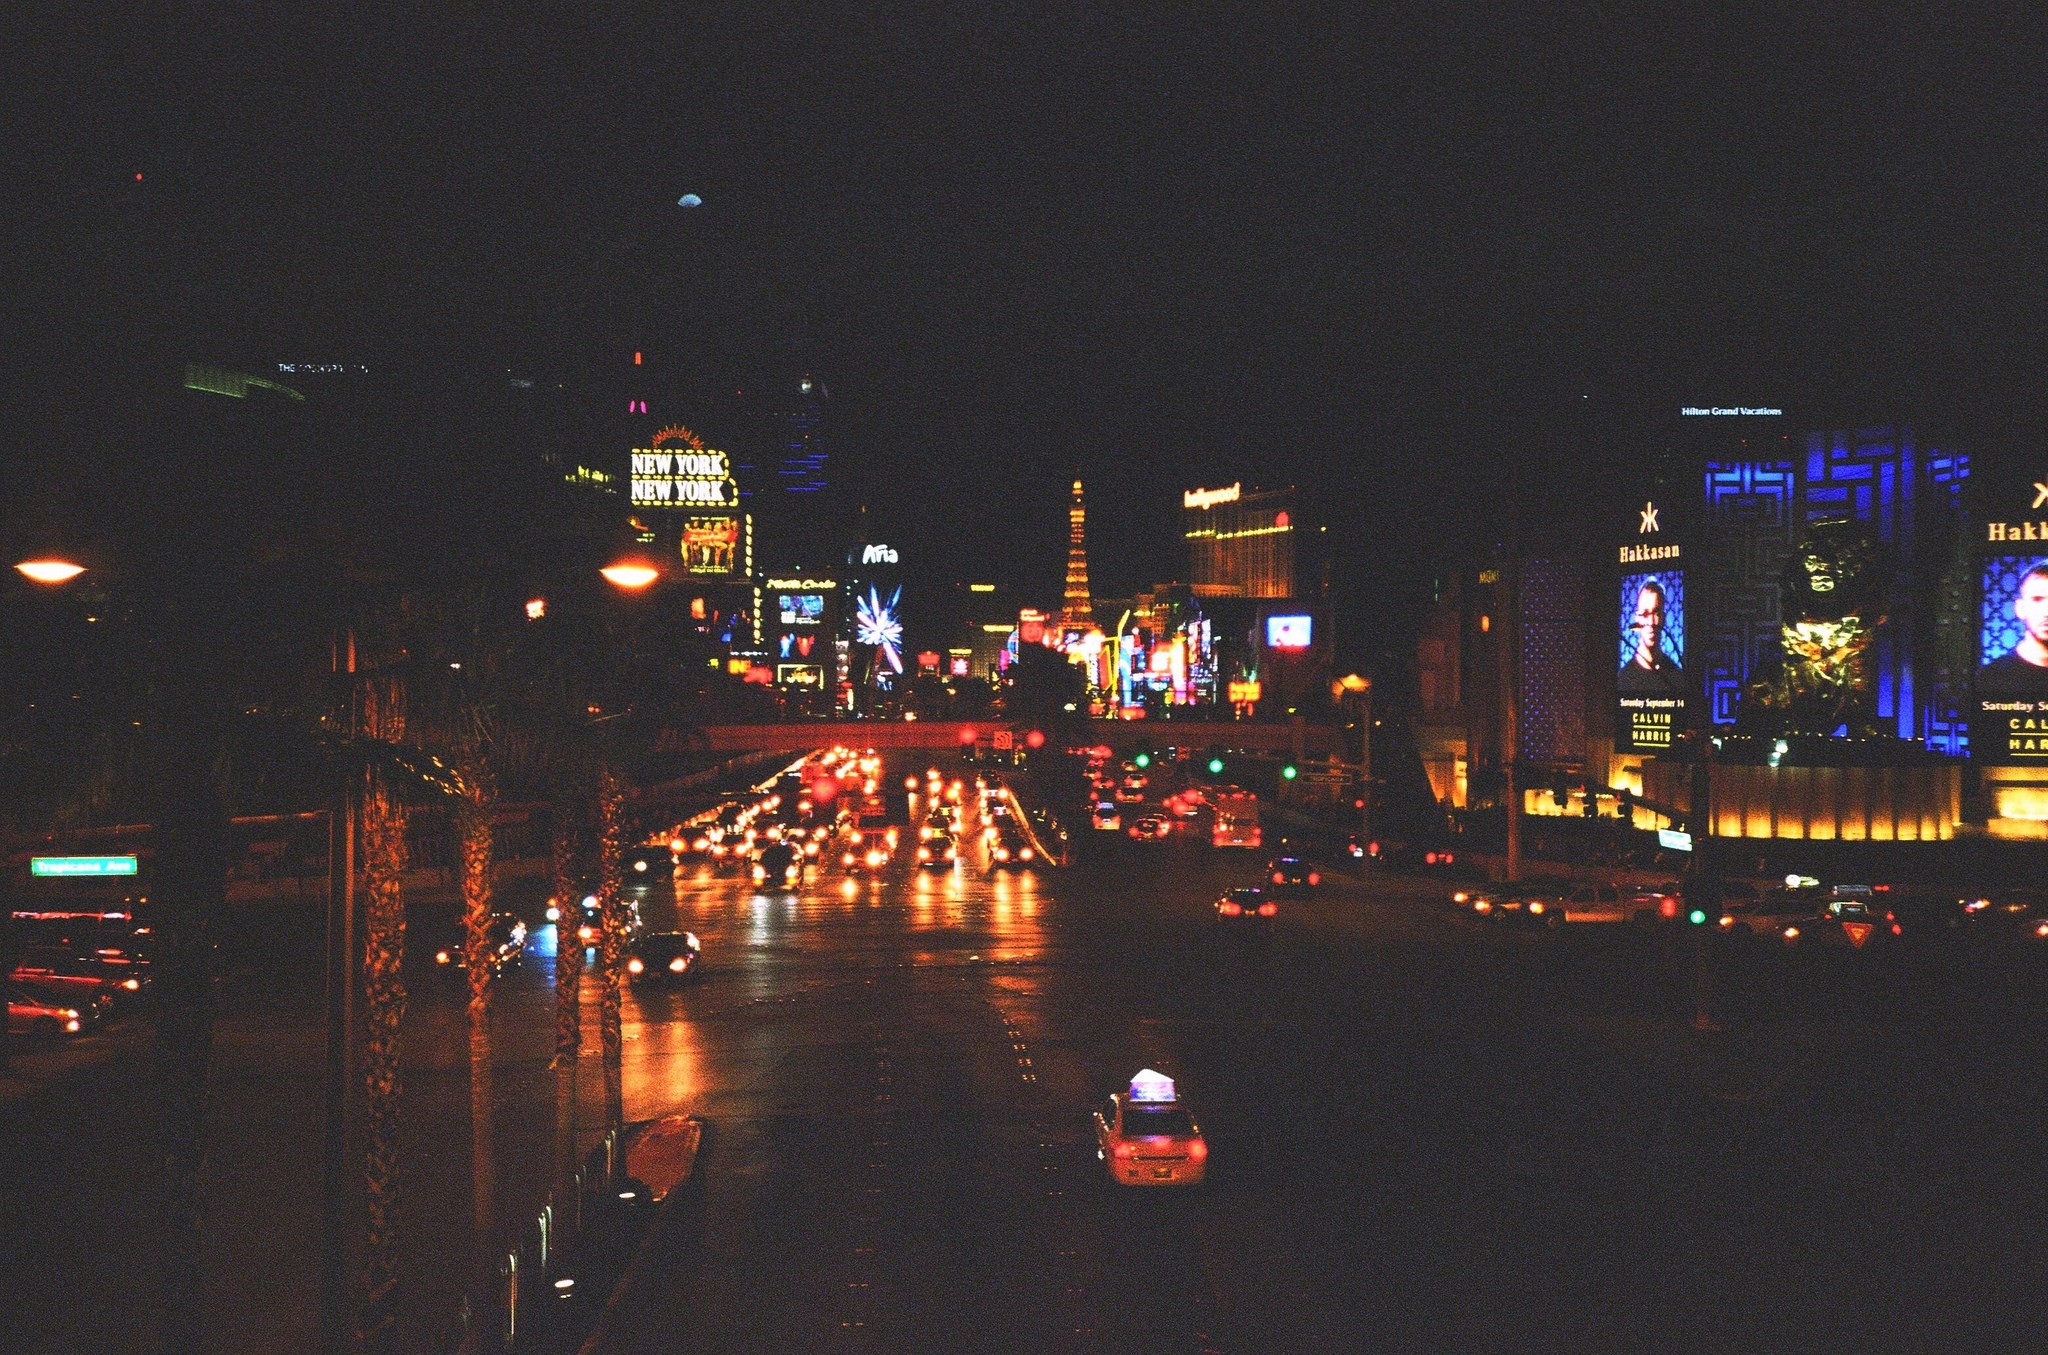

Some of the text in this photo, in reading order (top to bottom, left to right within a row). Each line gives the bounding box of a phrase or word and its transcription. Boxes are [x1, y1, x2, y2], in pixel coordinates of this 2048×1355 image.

[1681, 407, 1782, 416] Hilton Grand Vacations
[631, 453, 673, 475] NEW
[675, 454, 725, 476] YORK
[631, 479, 725, 502] NEW YORK
[862, 544, 899, 565] Aria
[1619, 543, 1680, 563] Hakkasan
[1645, 697, 1676, 710] September
[1982, 701, 2034, 713] Saturday
[1632, 712, 1671, 724] CALVIN
[2010, 718, 2048, 730] CAL
[1632, 730, 1671, 742] HARRIS
[37, 861, 131, 874] Tropicana Ave
